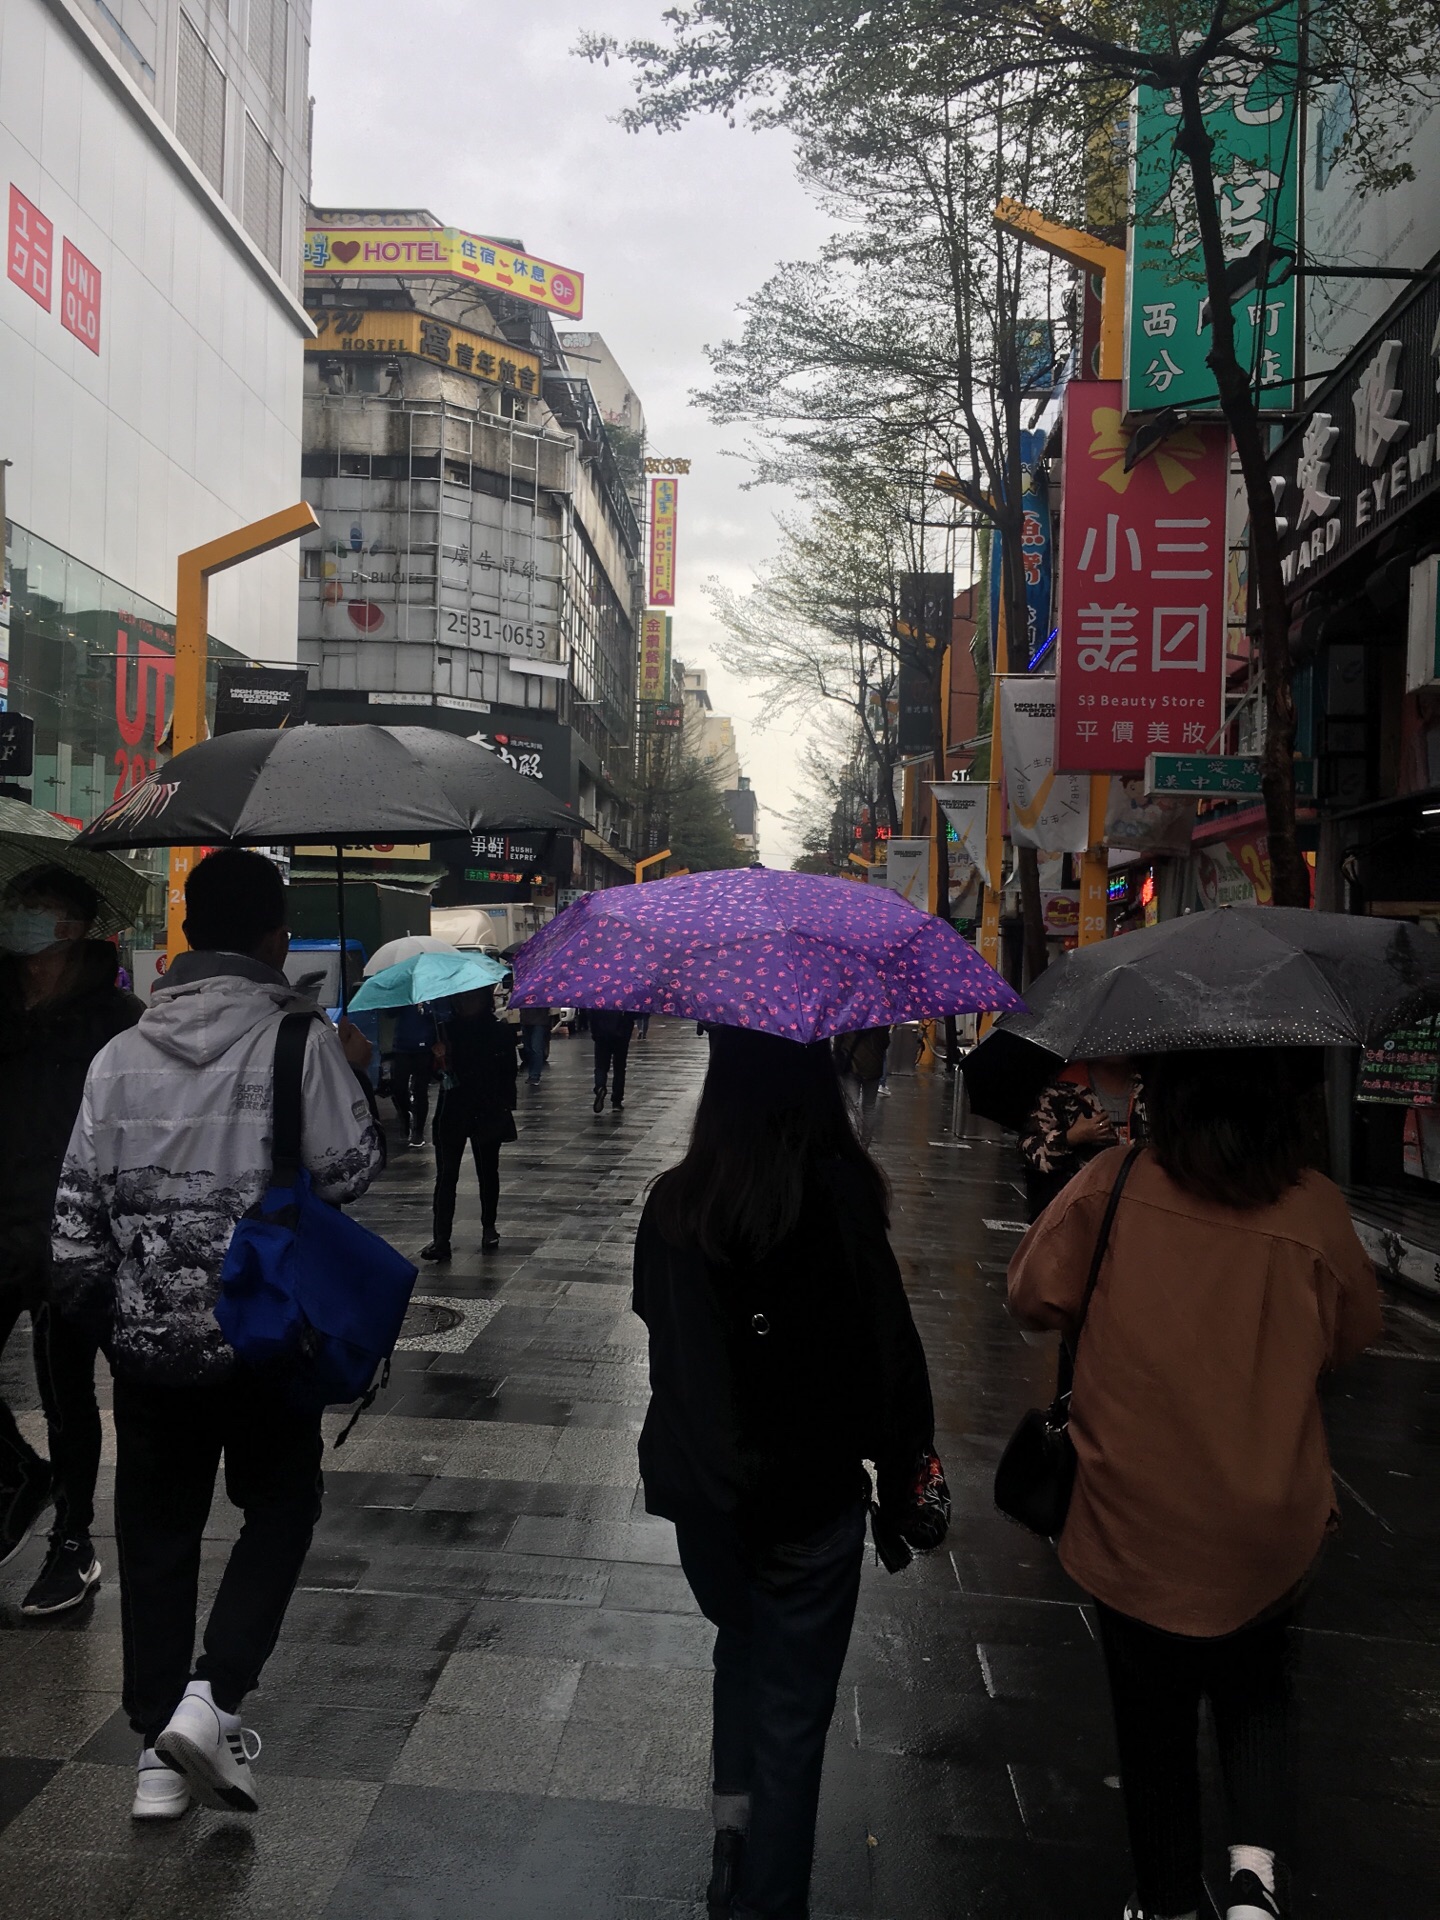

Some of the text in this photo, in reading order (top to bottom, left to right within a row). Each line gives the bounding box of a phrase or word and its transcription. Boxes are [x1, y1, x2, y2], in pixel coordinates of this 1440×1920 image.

[15, 202, 48, 259] ユニ
[363, 241, 448, 262] HOTEL
[12, 242, 47, 298] クロ
[67, 251, 94, 305] UNI
[552, 279, 574, 299] 9F
[66, 291, 96, 340] QLO
[1142, 297, 1286, 337] 西町
[342, 338, 409, 351] HOSTEL
[1145, 349, 1284, 392] 分店
[1356, 425, 1440, 528] EYEW
[655, 529, 666, 588] HOTEL
[447, 612, 546, 649] 2531-0653
[230, 693, 290, 701] BASKETBALL
[253, 689, 291, 697] SCHOOL
[1078, 695, 1206, 709] S3 Beauty Store
[1076, 721, 1206, 744] 平價美妝
[470, 835, 505, 859] 爭鮮
[175, 857, 188, 872] H
[1089, 885, 1102, 899] H
[987, 916, 995, 925] H
[1085, 916, 1105, 931] 29
[983, 937, 997, 947] 27
